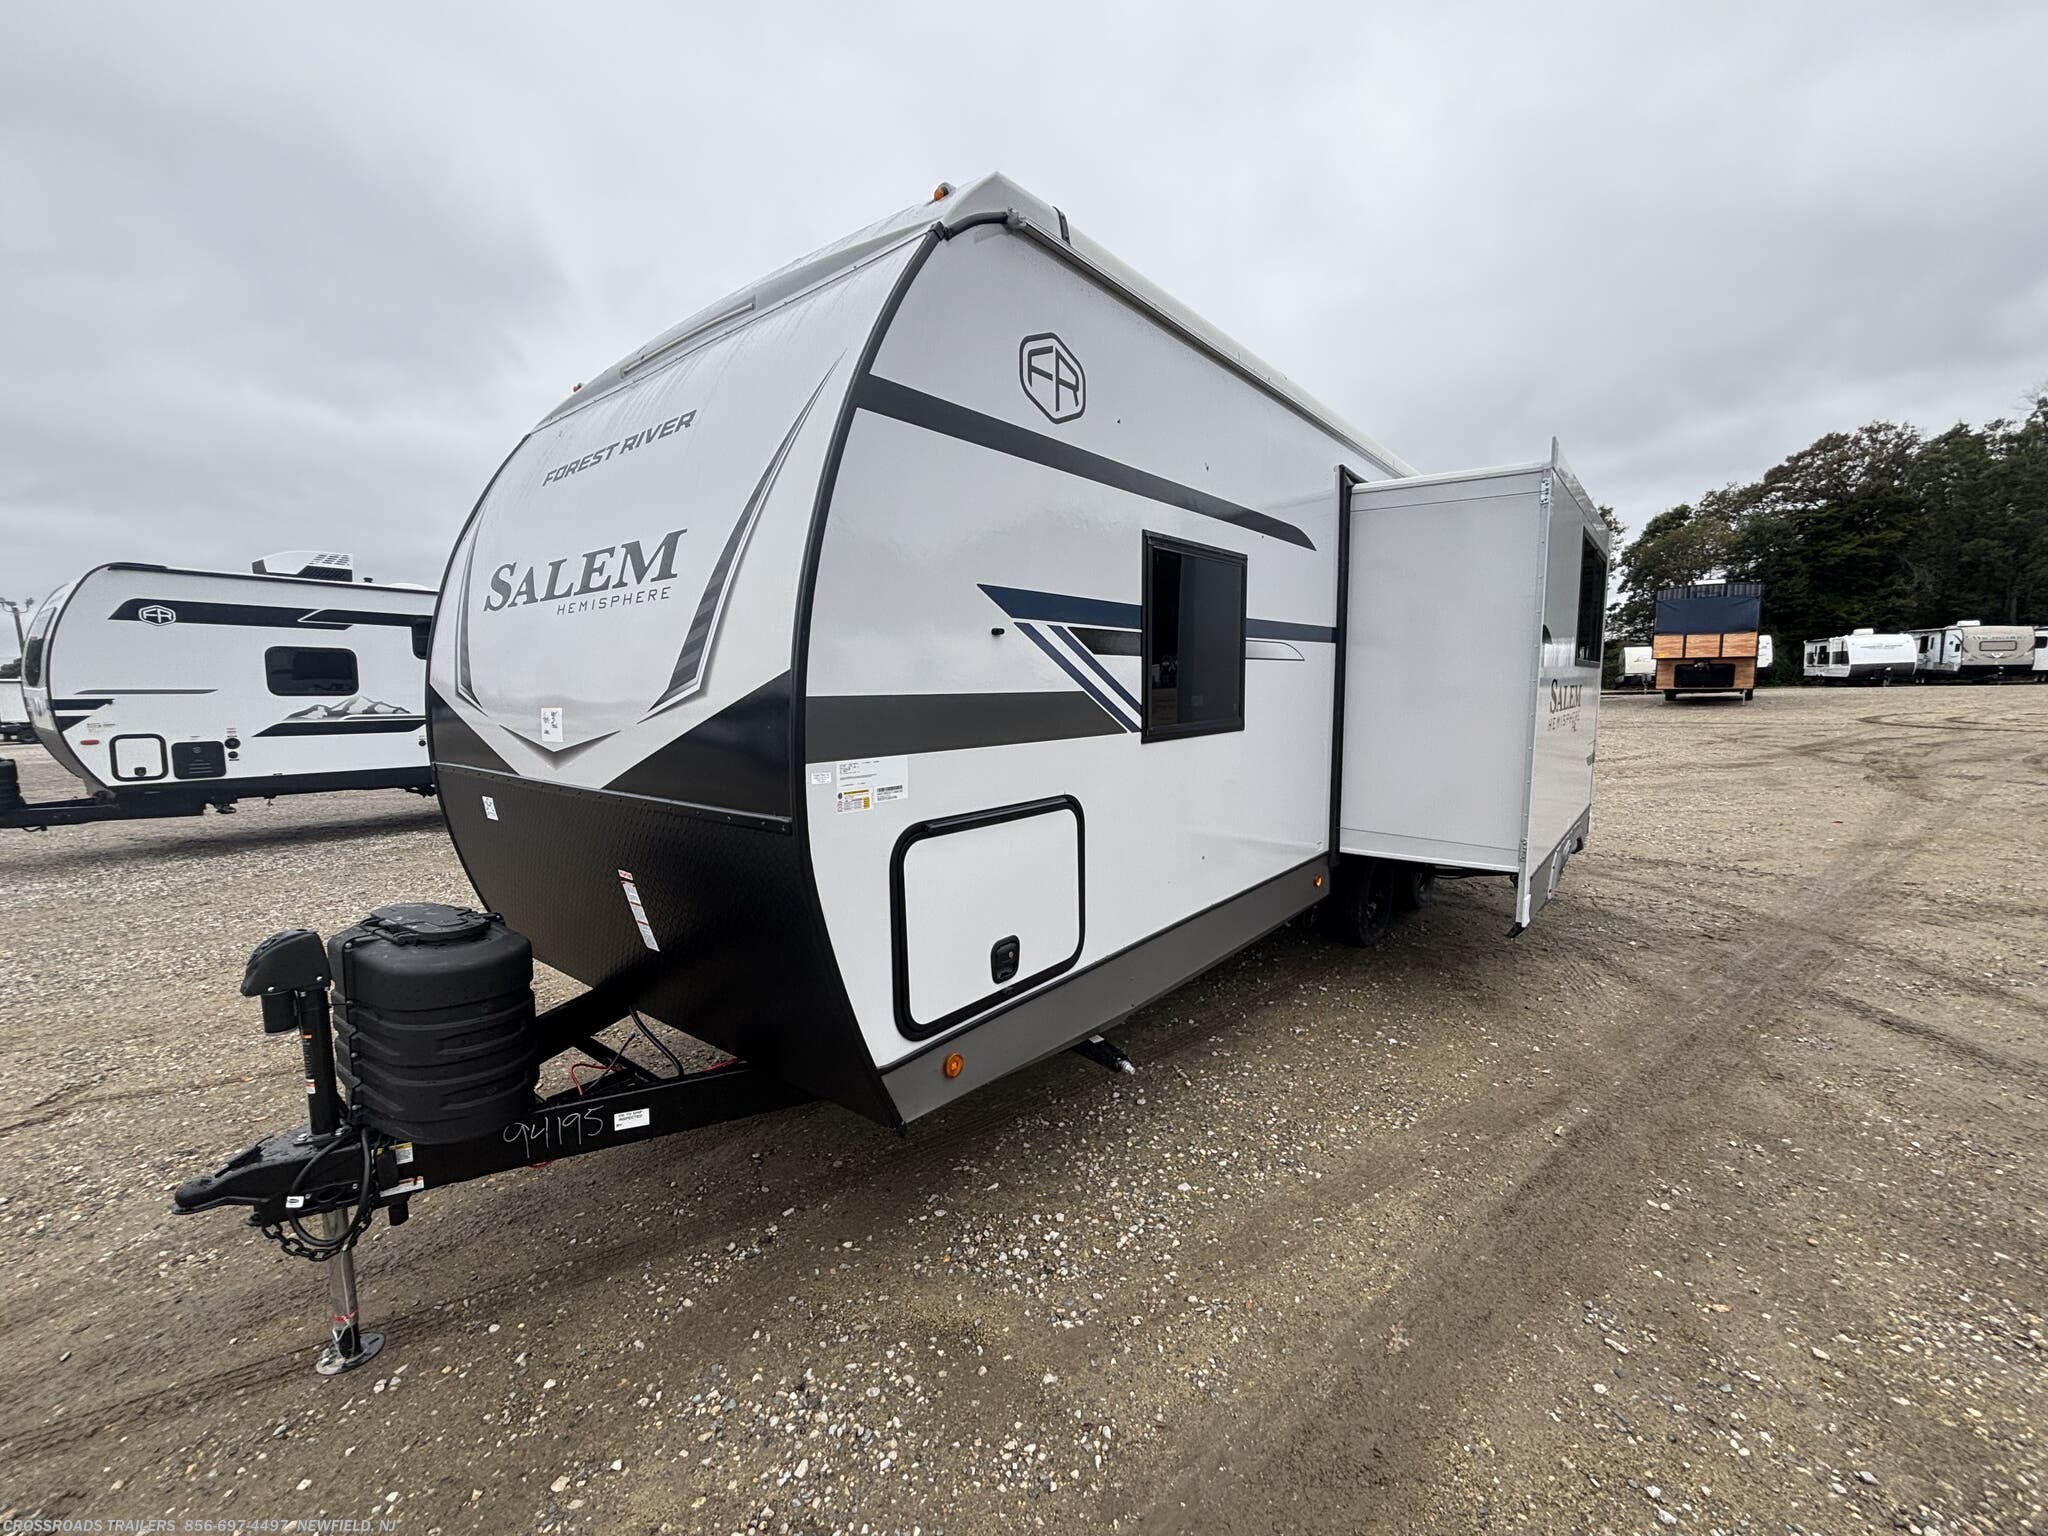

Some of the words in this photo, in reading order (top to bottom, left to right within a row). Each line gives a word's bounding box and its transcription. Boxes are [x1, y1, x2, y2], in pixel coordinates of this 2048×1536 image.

[542, 440, 620, 487] FOREST
[619, 409, 697, 455] RIVER
[484, 528, 688, 612] SALEM
[556, 586, 672, 615] HEMISPHERE
[1549, 678, 1583, 714] SALEM
